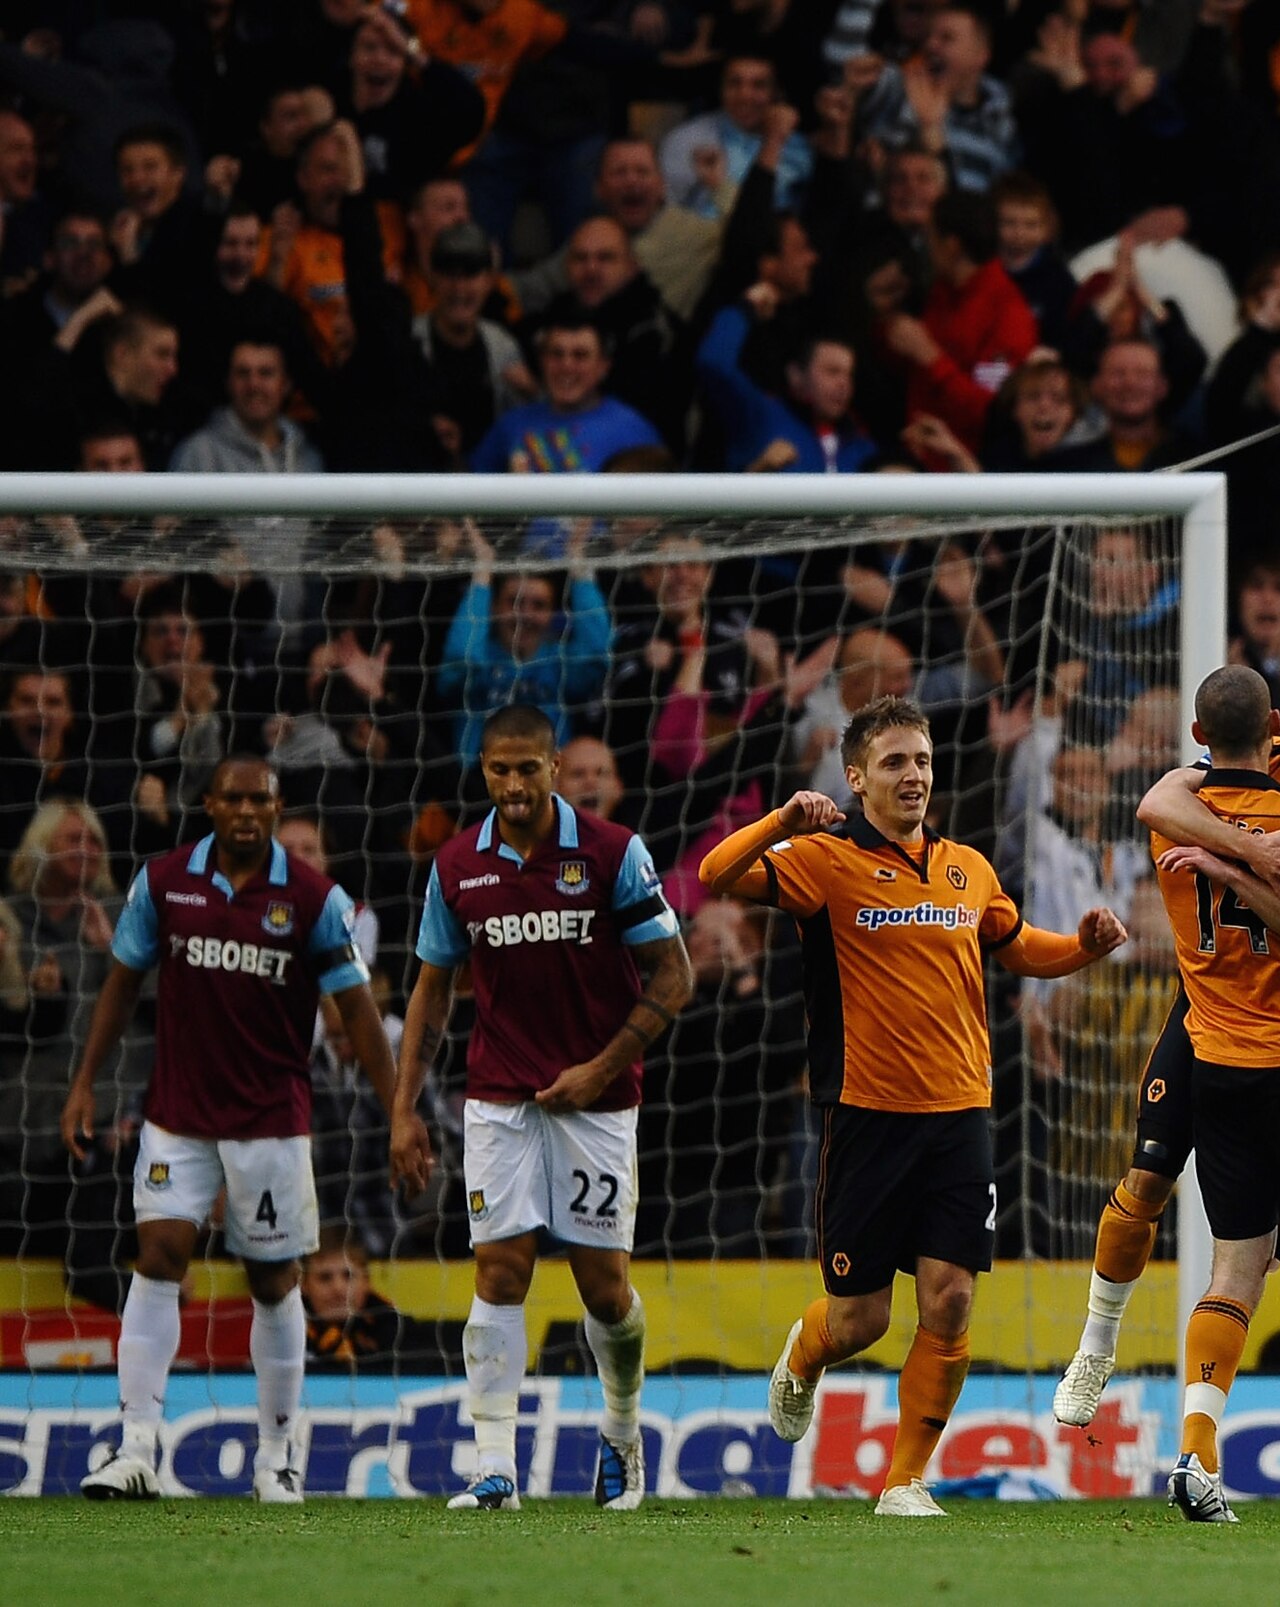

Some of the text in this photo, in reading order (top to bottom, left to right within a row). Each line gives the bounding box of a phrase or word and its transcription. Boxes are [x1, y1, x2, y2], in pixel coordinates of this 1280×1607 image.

[458, 873, 501, 891] macron
[484, 910, 596, 948] SBOBET
[1194, 869, 1270, 954] 14
[185, 935, 293, 985] SBOBET
[256, 1189, 277, 1229] 4
[569, 1168, 619, 1218] 22
